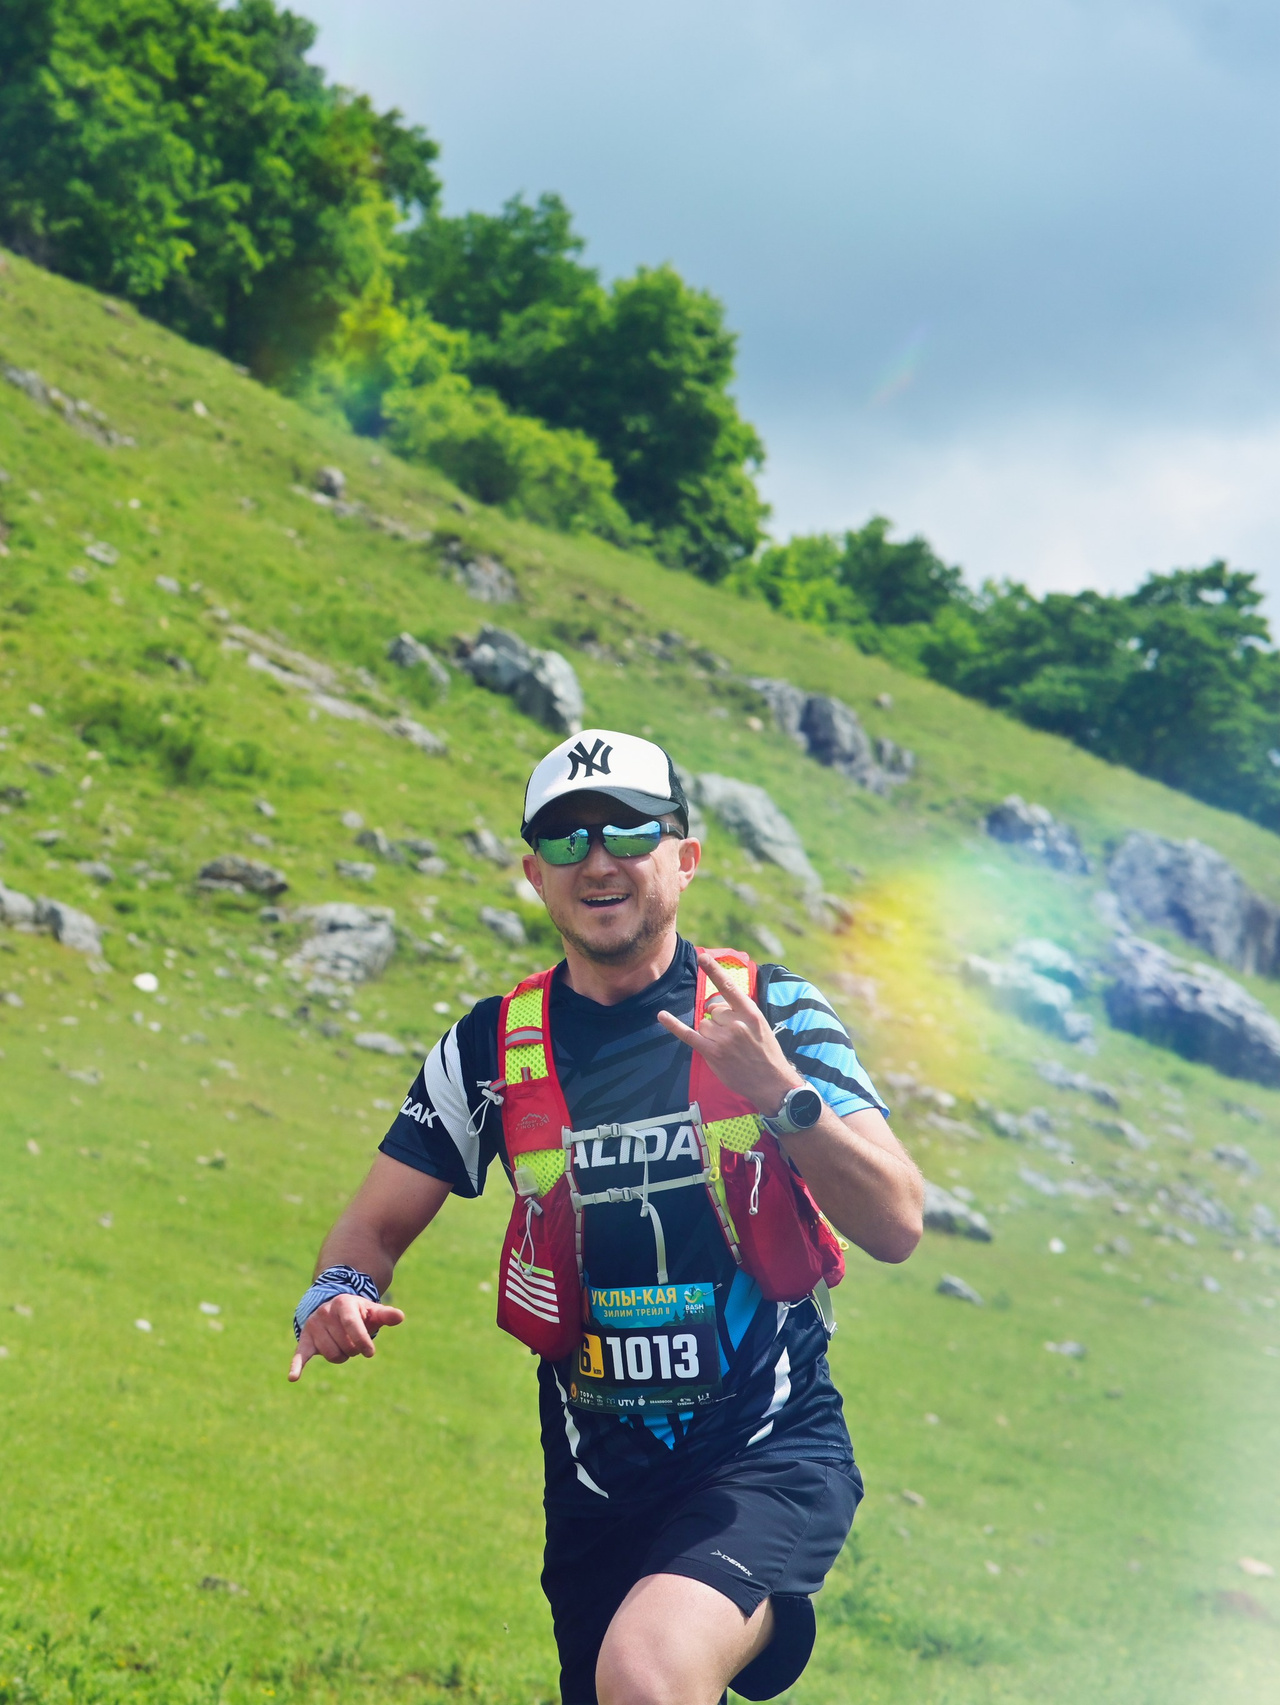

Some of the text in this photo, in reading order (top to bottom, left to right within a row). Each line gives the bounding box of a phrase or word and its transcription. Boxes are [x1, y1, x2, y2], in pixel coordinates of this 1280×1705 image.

[591, 1287, 677, 1307] УКЛЫ-КАЯ
[603, 1309, 633, 1318] ЗИЛИМ
[635, 1306, 664, 1317] ТРЕЙЛ
[685, 1303, 704, 1311] BASH
[580, 1336, 591, 1373] 6
[606, 1333, 700, 1380] 1013
[617, 1399, 635, 1407] UTV
